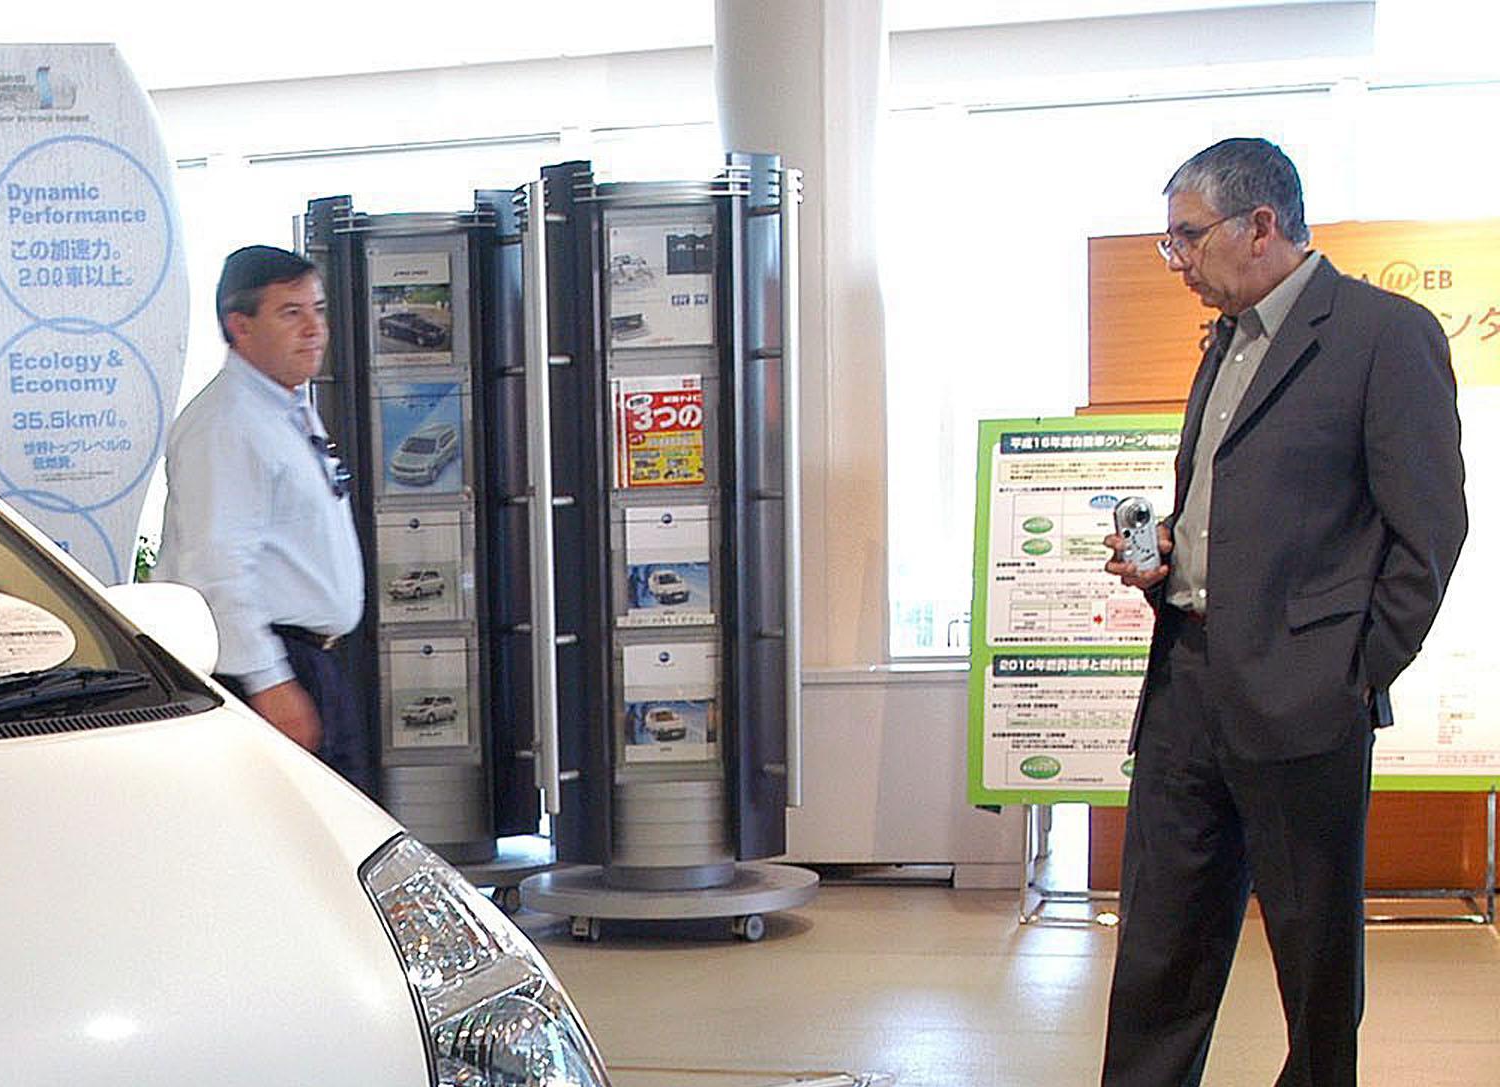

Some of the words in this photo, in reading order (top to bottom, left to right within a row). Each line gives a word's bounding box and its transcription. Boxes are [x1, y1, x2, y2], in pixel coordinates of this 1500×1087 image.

[7, 183, 99, 204] Dynamic
[8, 206, 146, 224] Performance
[10, 239, 121, 262] この加速力。
[9, 351, 101, 371] Ecology
[107, 350, 124, 368] &
[11, 376, 117, 395] Economy
